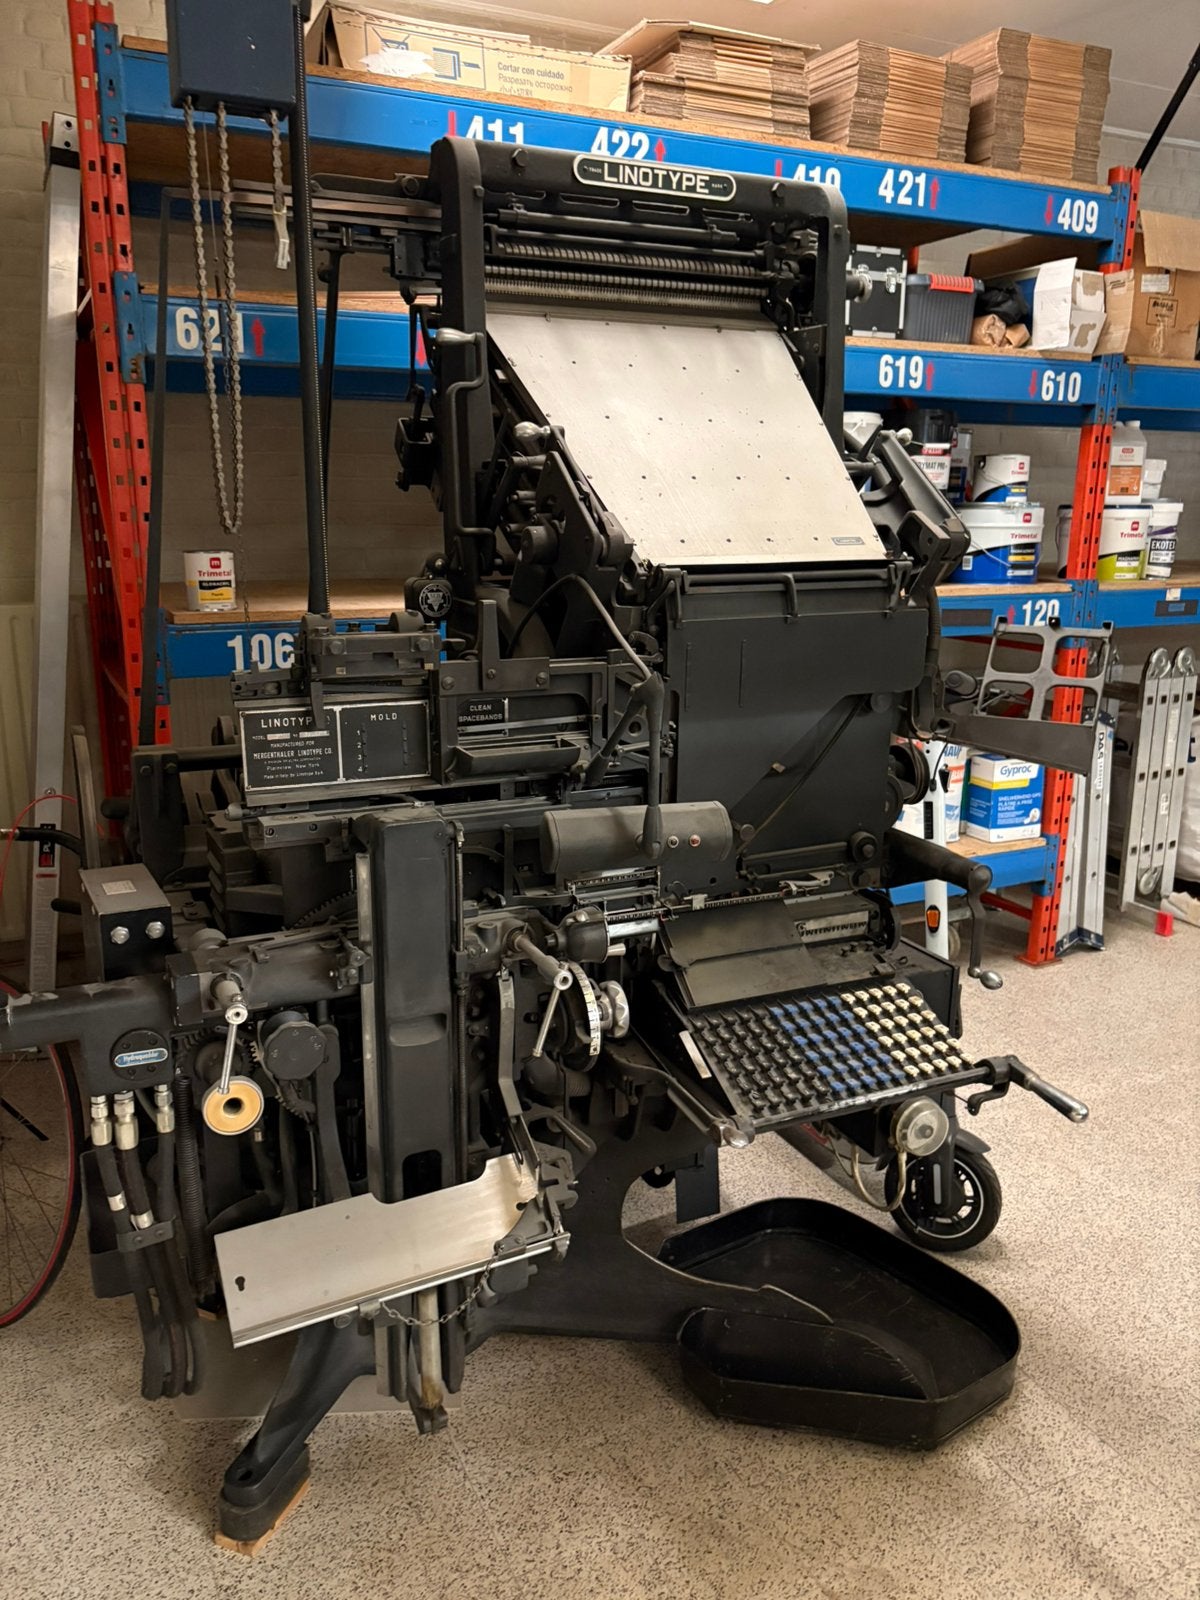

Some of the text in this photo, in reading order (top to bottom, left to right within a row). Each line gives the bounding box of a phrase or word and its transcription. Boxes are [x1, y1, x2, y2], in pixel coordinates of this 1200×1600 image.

[497, 62, 565, 80] Cortar con cuidado
[590, 126, 650, 160] 422
[603, 162, 710, 194] LINOTYPE
[878, 168, 927, 207] 421
[1057, 198, 1099, 234] 409
[878, 354, 924, 390] 619
[1041, 370, 1082, 403] 610
[197, 570, 233, 578] Trimetal
[1022, 598, 1060, 627] 120
[226, 632, 296, 672] 106
[370, 712, 398, 721] MOLD
[458, 713, 503, 722] SPACEBANDS
[469, 704, 492, 712] CLEAN
[253, 750, 295, 760] MERGENTHALER
[297, 747, 323, 757] LINOTYPE
[270, 741, 305, 749] MANUFACTURED
[1000, 764, 1032, 778] Gyproc
